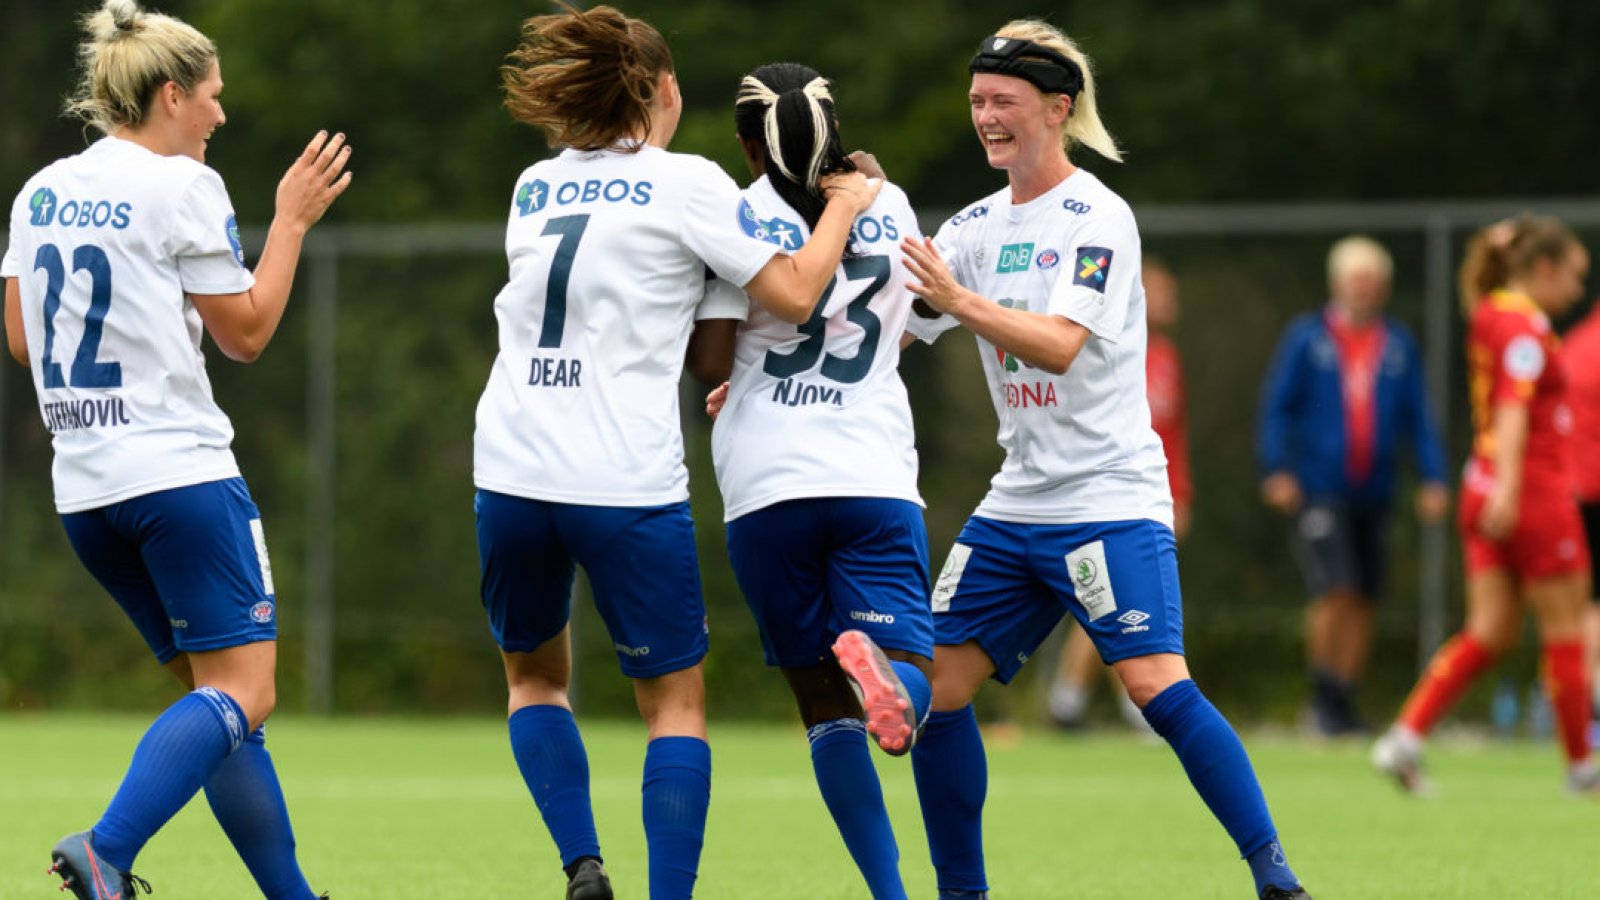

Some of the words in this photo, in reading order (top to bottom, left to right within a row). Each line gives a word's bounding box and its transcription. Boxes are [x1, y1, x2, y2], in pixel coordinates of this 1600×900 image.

[556, 179, 653, 206] OBOS
[58, 200, 132, 230] OBOS
[1001, 248, 1030, 271] DNB
[538, 213, 592, 349] 7
[34, 243, 123, 389] 22
[763, 255, 891, 384] 33
[528, 357, 582, 388] DEAR
[851, 610, 895, 625] umbro
